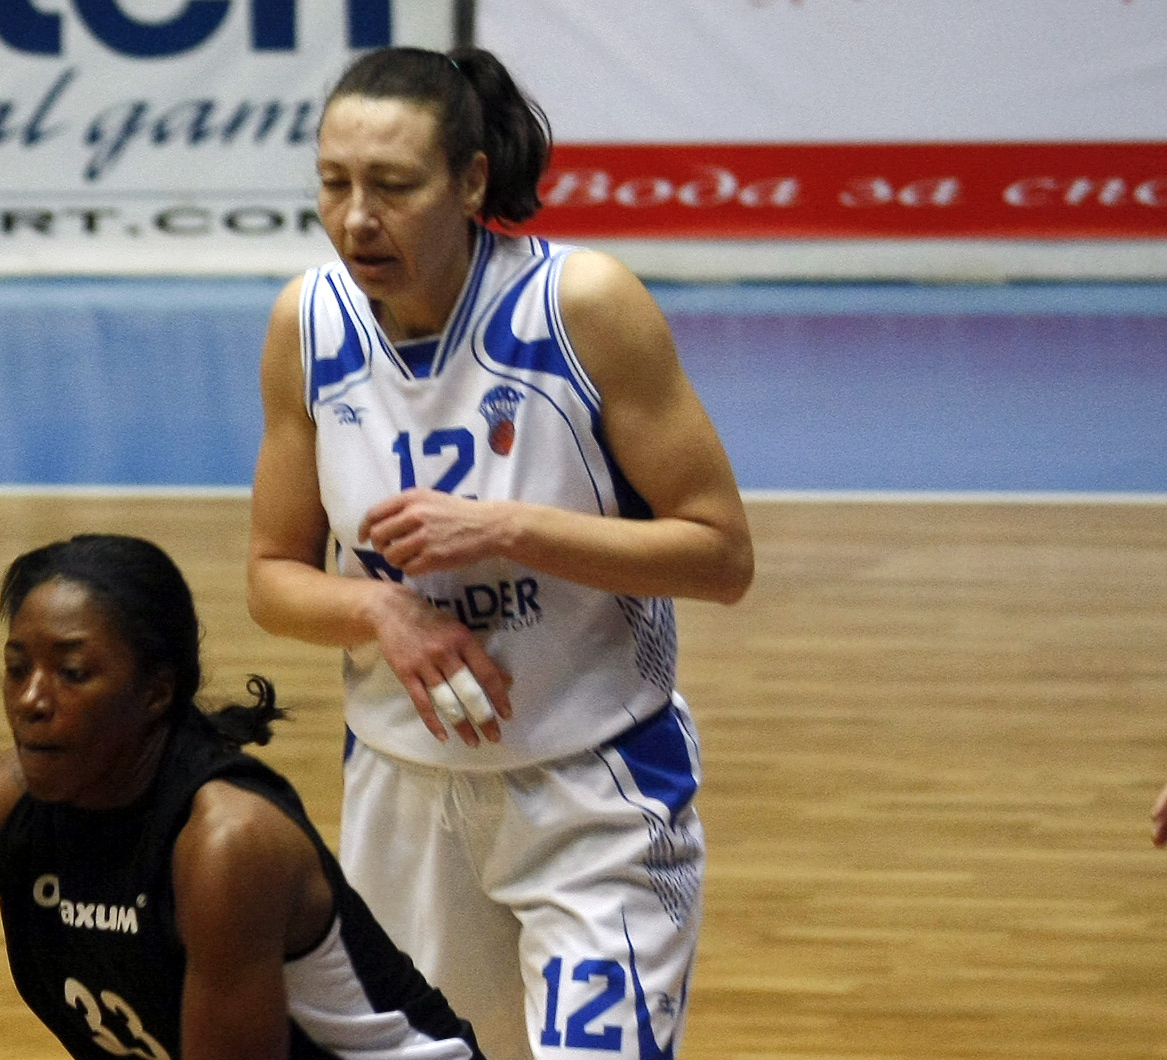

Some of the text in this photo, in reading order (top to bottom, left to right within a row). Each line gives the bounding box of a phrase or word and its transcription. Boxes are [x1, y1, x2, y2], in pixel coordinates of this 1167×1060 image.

[83, 97, 317, 181] gam
[391, 427, 478, 500] 12
[540, 956, 626, 1052] 12
